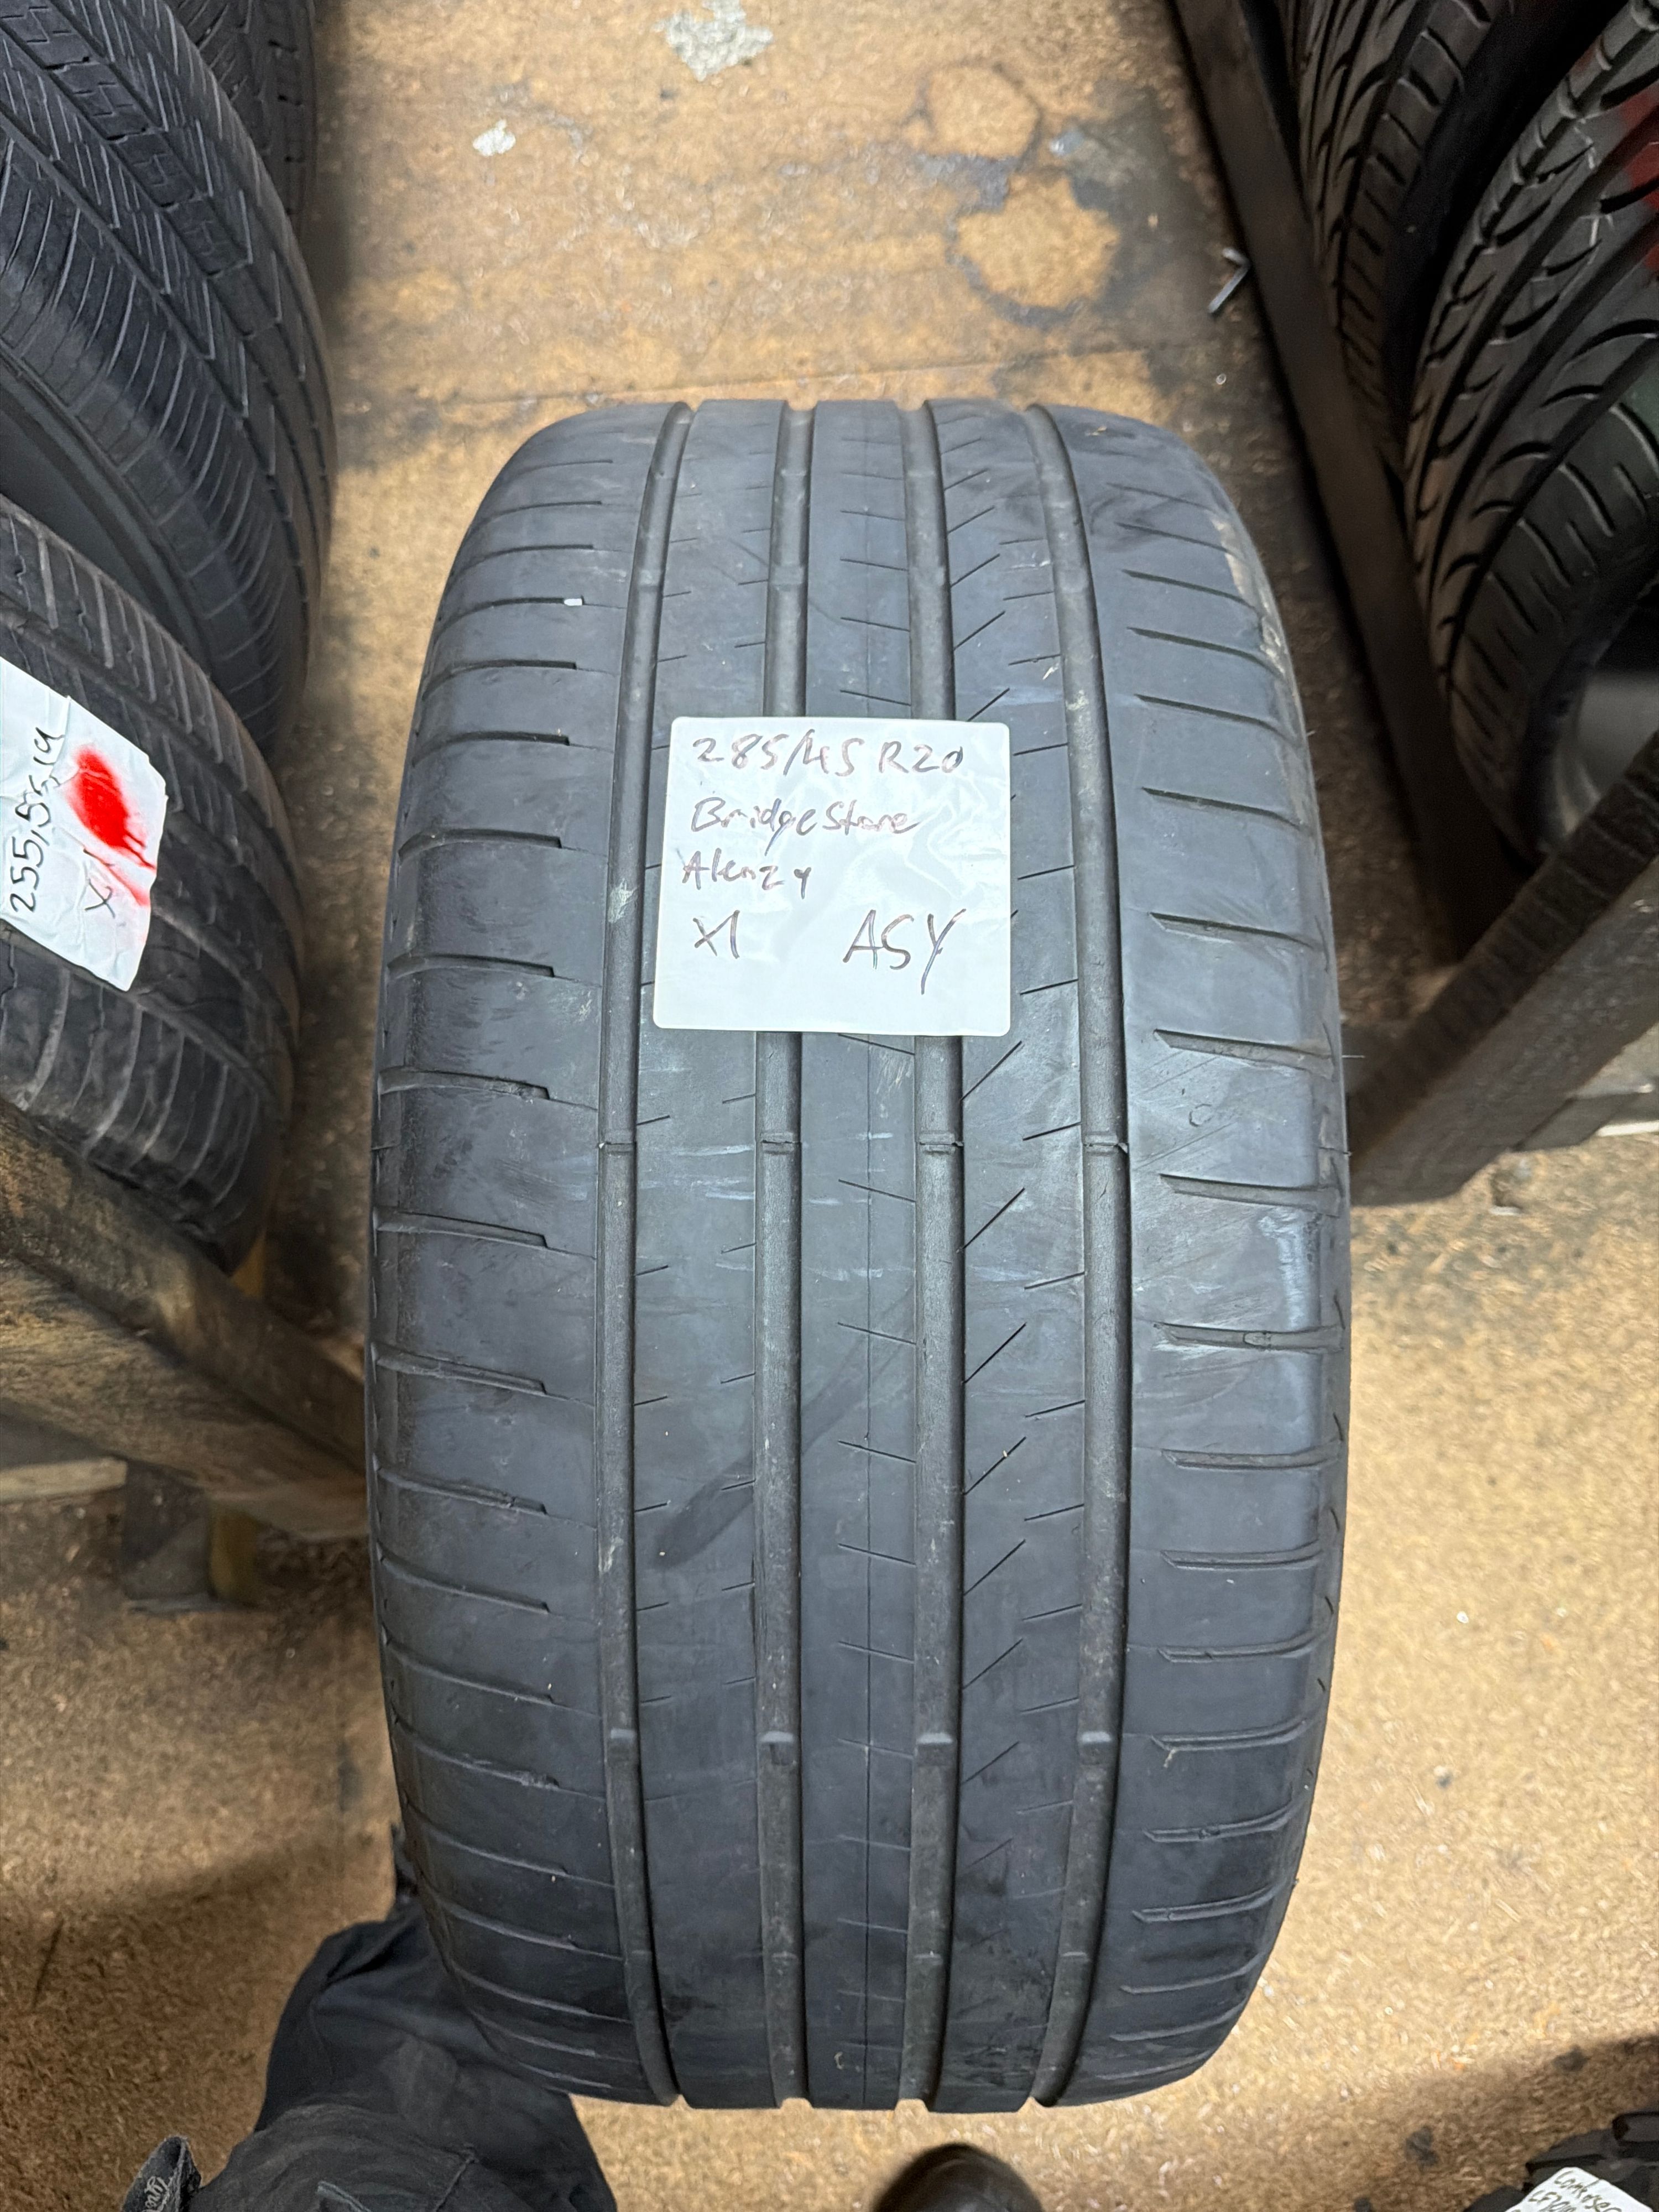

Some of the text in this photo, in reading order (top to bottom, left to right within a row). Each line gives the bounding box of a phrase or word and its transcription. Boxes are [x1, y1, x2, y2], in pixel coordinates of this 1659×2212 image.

[692, 729, 964, 777] 285/45 R20
[842, 908, 967, 995] ASY
